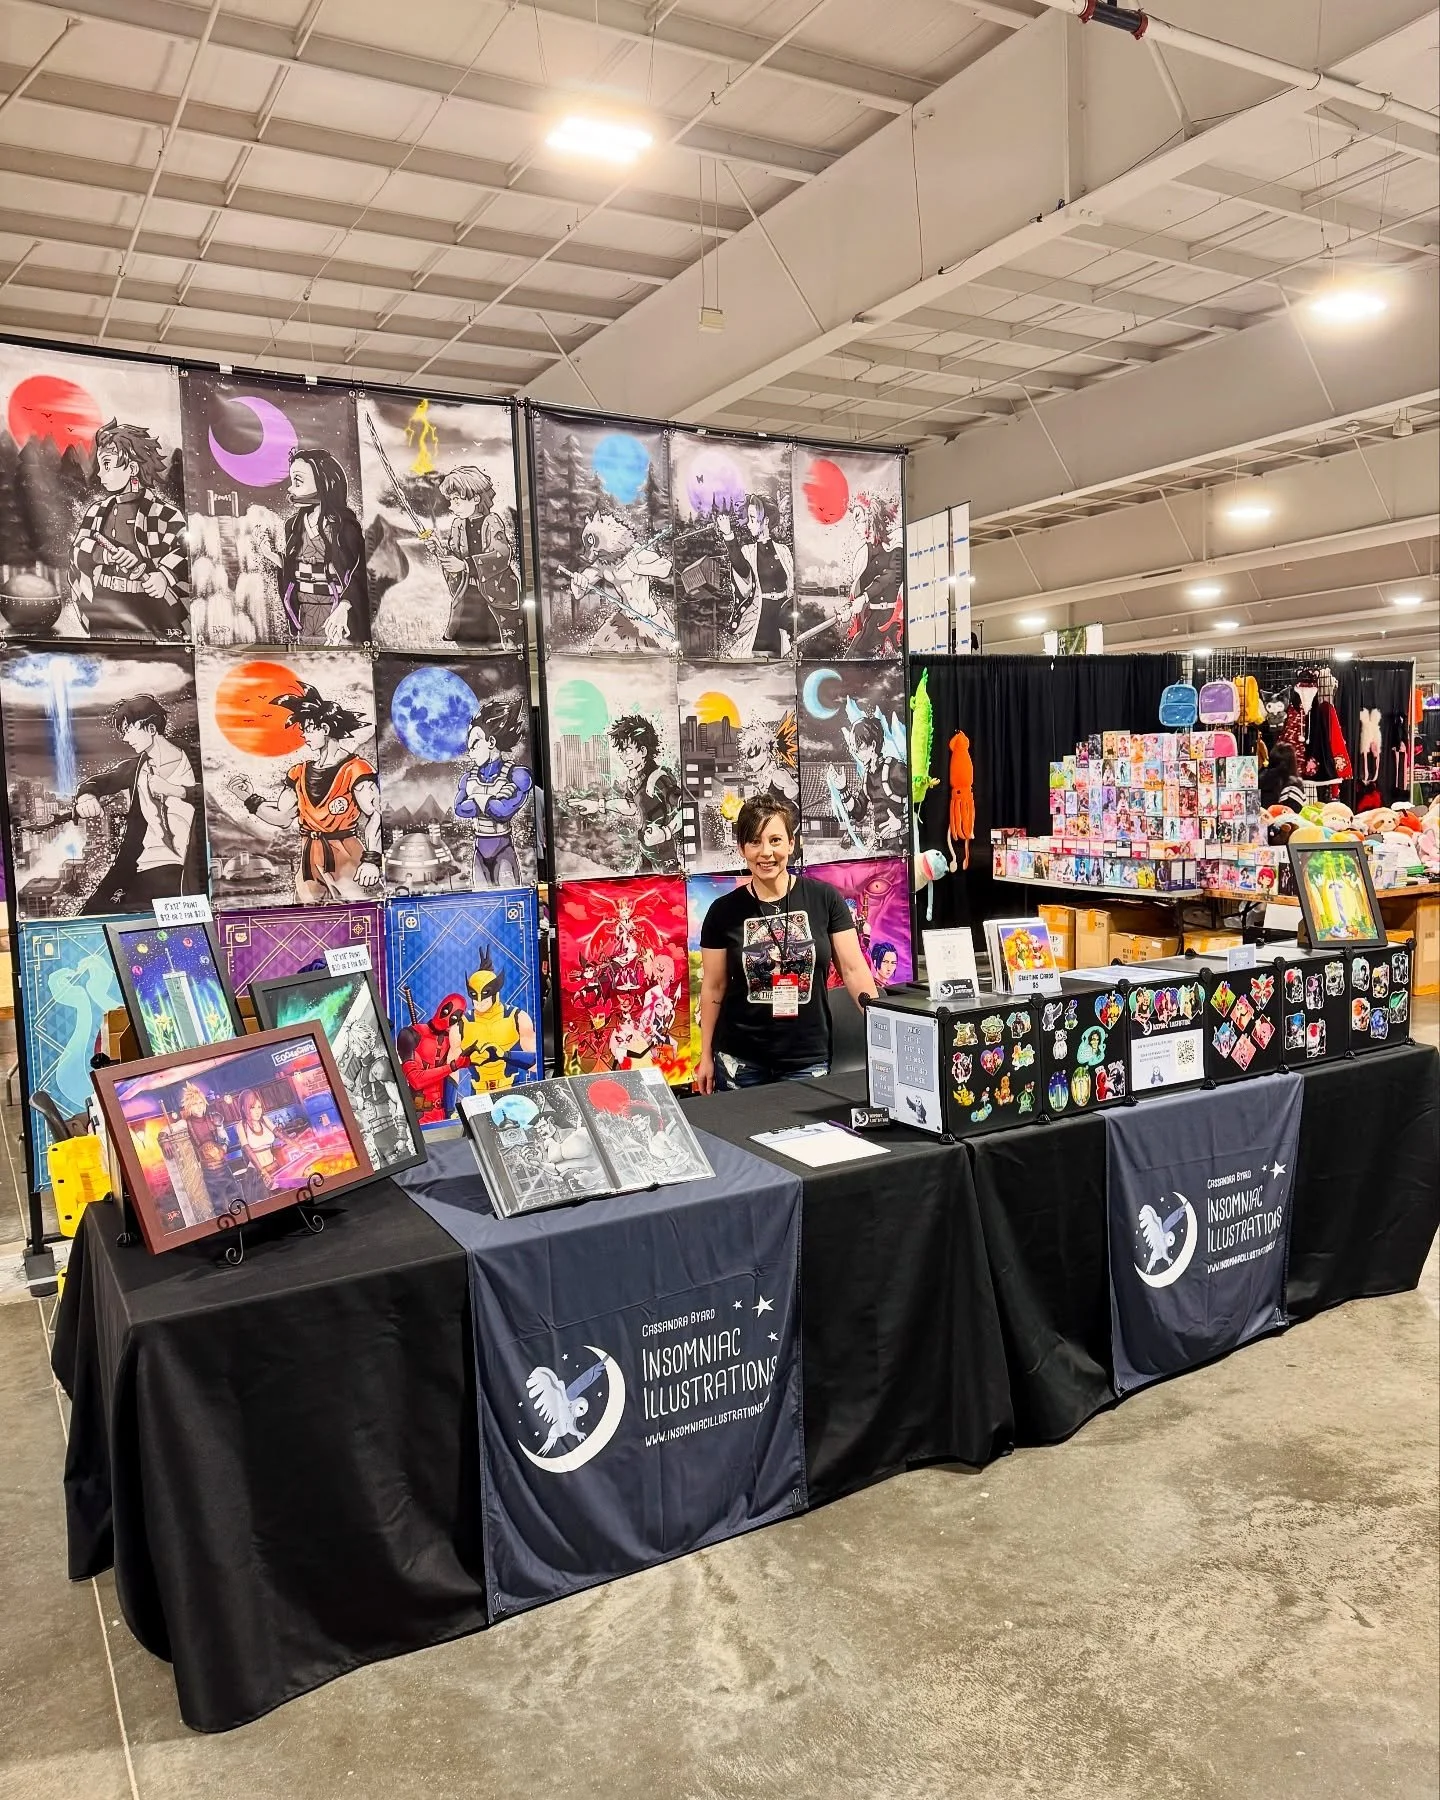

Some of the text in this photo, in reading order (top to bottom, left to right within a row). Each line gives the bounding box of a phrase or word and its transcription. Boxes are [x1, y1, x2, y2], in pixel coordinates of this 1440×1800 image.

[179, 912, 184, 920] 2
[184, 911, 194, 919] FOR
[1207, 1169, 1252, 1190] CASSANDRA BYARD
[1207, 1185, 1263, 1224] INSOMNIAC
[1207, 1206, 1283, 1254] ILLUSTRATIONS
[642, 1308, 716, 1338] CASSANDRA BYARD
[642, 1327, 741, 1382] INSOMNIAC
[643, 1355, 778, 1421] ILLUSTRATIONS
